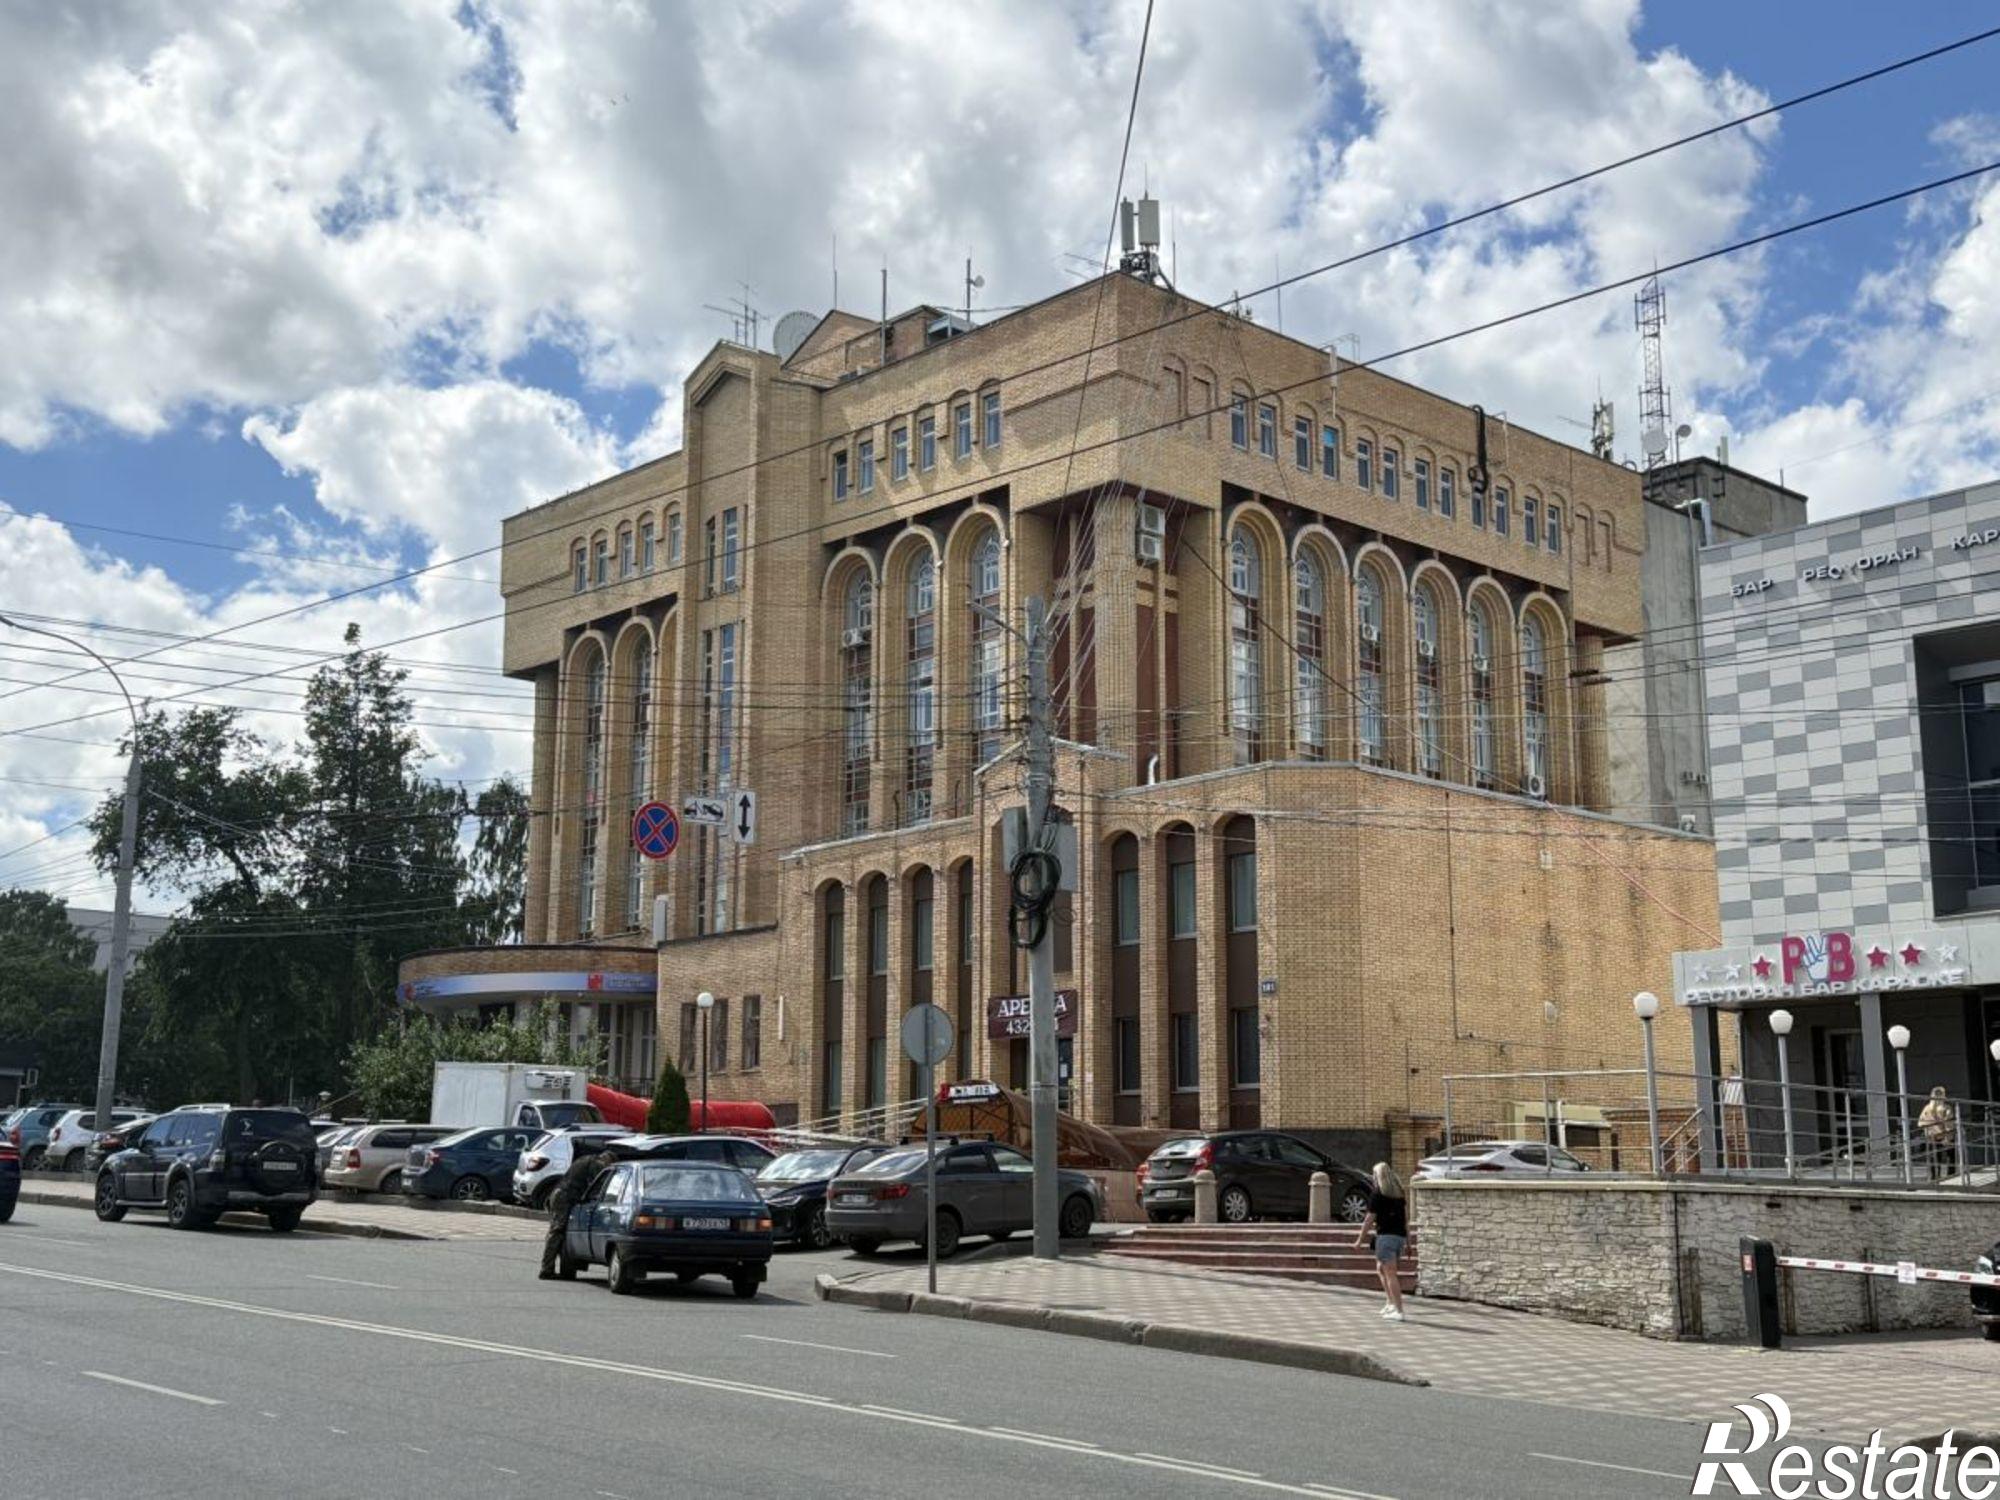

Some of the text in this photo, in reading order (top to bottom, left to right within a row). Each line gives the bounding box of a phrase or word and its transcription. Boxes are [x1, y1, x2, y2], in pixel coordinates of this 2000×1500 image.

[1730, 577, 1773, 597] БАР
[1800, 981, 1845, 995] БАР
[998, 994, 1067, 1018] АРЕА
